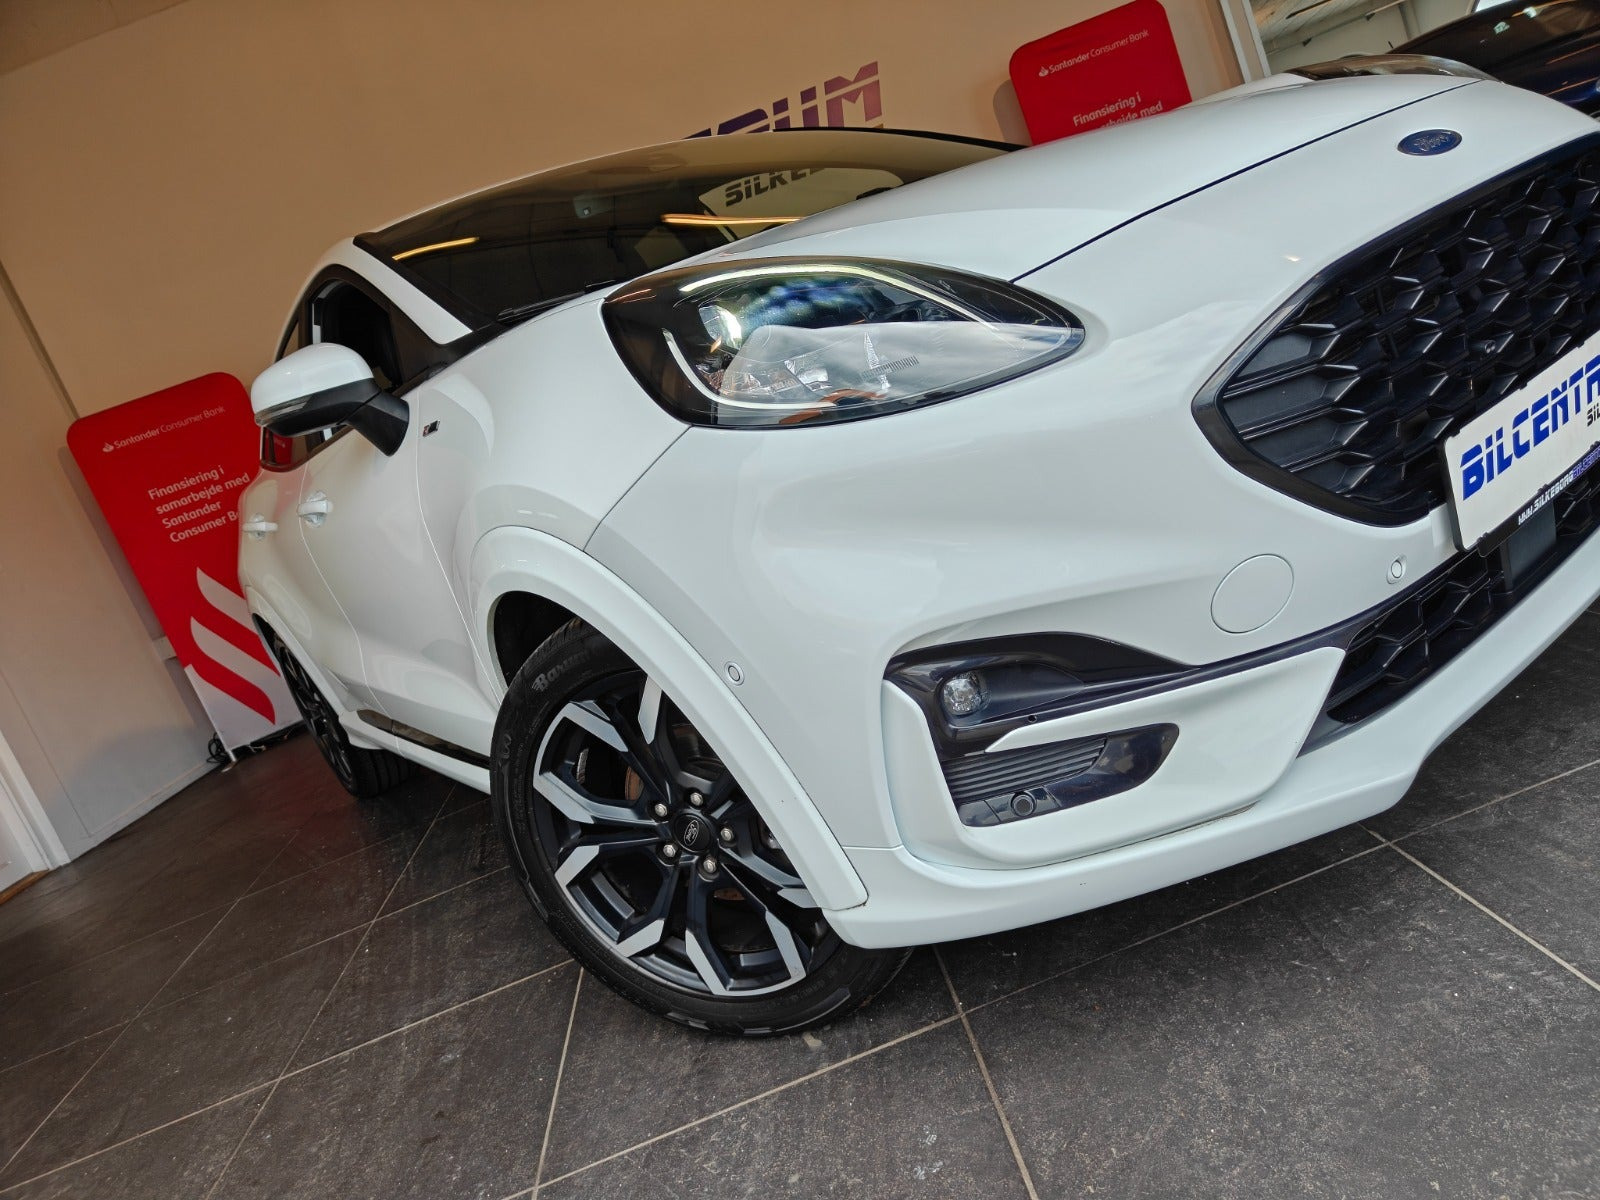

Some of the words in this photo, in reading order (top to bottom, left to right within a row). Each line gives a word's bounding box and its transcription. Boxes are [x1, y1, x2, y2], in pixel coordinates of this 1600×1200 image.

[1049, 51, 1089, 74] Santander
[1090, 39, 1129, 58] Consumer
[1129, 29, 1149, 42] Bank
[1073, 97, 1137, 127] Finansiering
[1136, 91, 1141, 102] i
[1140, 101, 1163, 118] med
[114, 428, 160, 449] Santander
[161, 414, 203, 432] Consumer
[203, 406, 225, 419] Bank
[148, 469, 220, 500] Finansiering
[219, 465, 224, 475] i
[156, 482, 223, 514] samarbejde
[225, 473, 250, 490] med
[162, 501, 222, 528] Santander
[169, 515, 226, 543] Consumer
